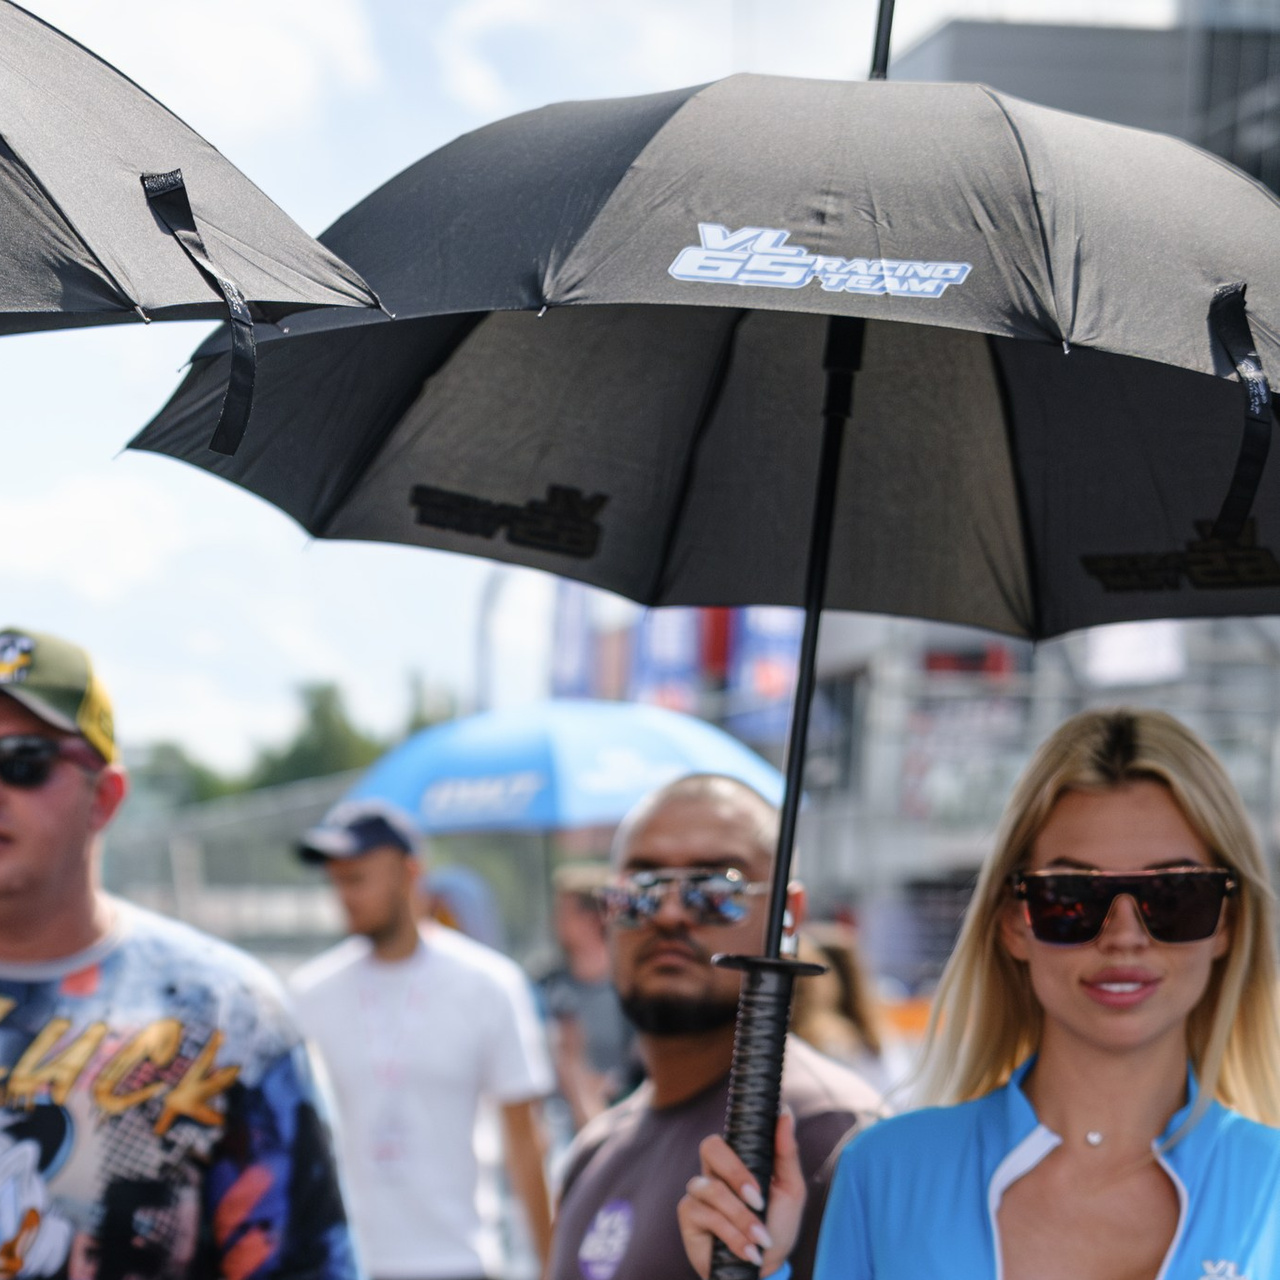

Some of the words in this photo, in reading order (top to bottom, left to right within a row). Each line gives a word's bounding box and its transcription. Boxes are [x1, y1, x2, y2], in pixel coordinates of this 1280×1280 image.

[699, 224, 804, 254] VL
[672, 249, 815, 284] 65
[813, 257, 961, 280] RACING
[824, 271, 941, 293] TEAM
